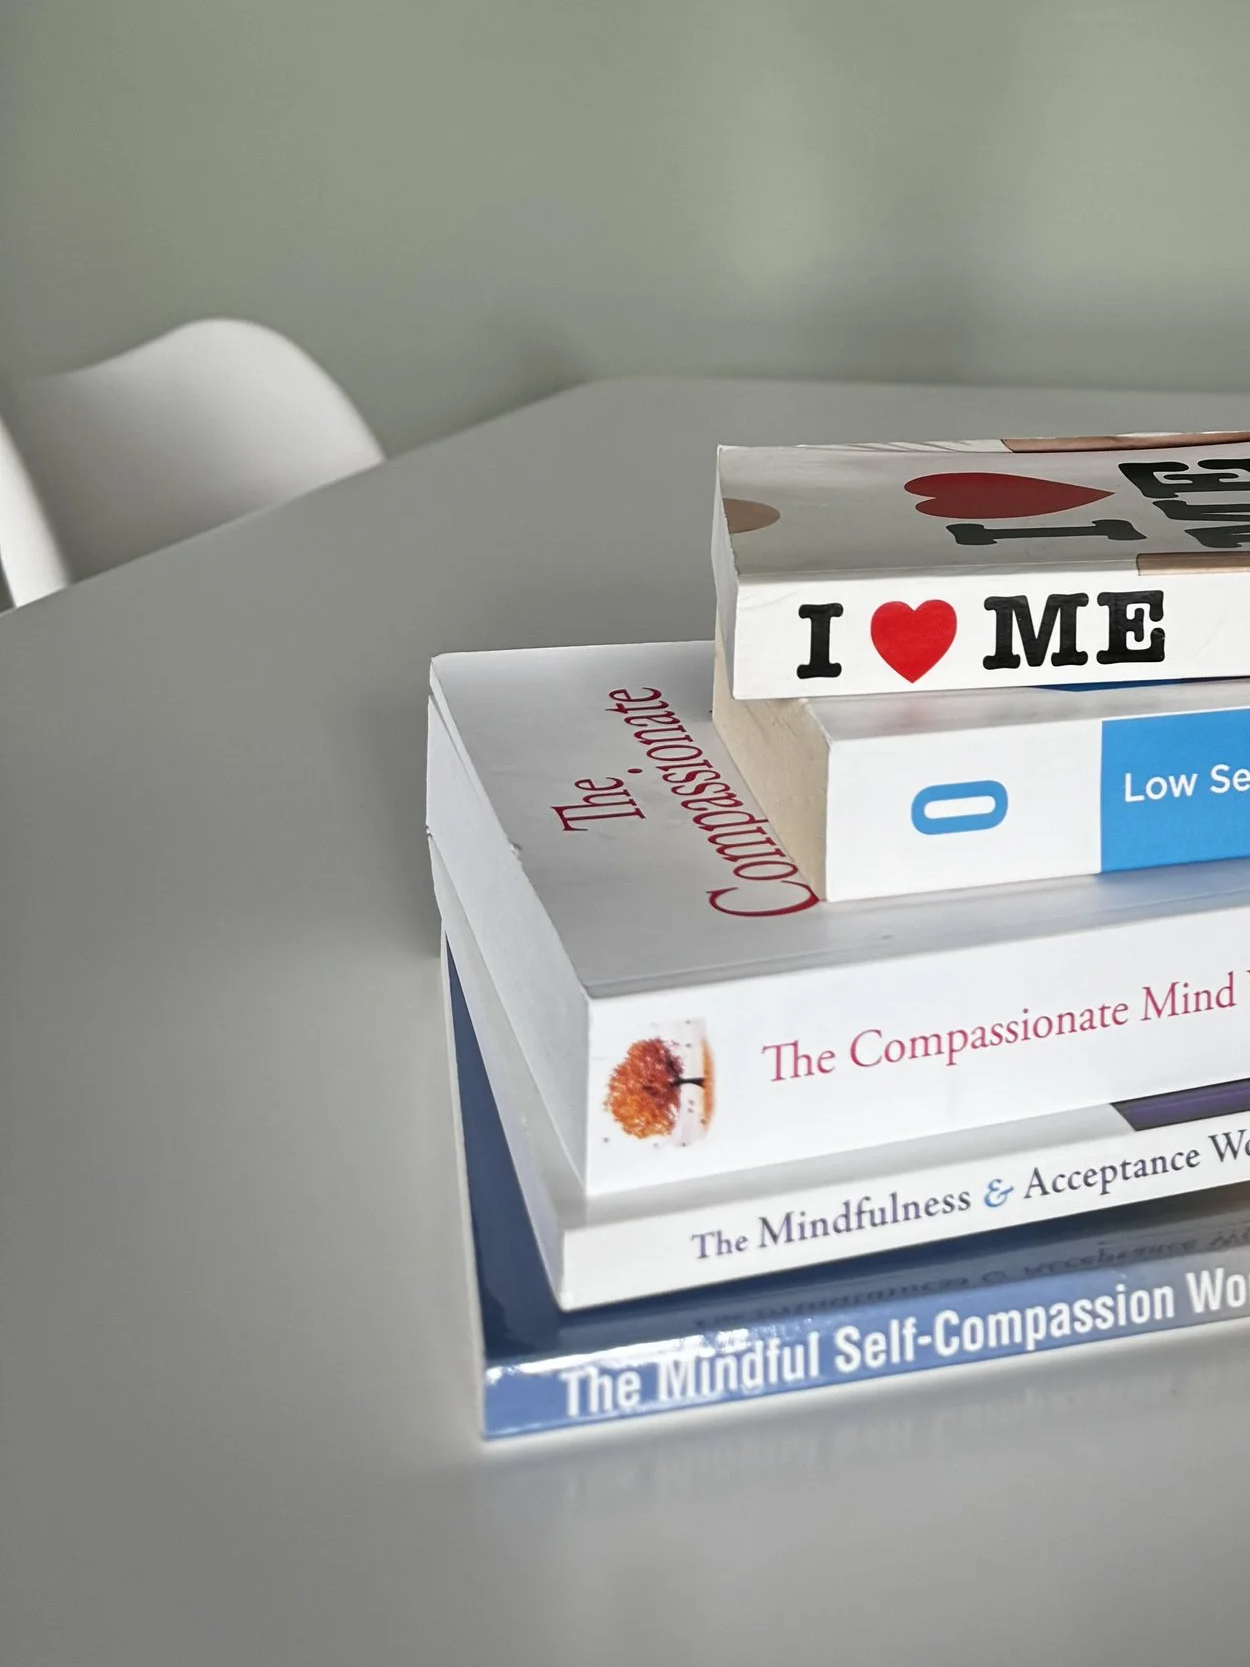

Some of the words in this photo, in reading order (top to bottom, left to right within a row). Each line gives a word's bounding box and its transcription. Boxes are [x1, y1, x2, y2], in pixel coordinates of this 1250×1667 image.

[946, 518, 1148, 546] I
[796, 602, 842, 679] I
[982, 589, 1165, 671] ME
[551, 776, 646, 832] The
[605, 686, 821, 918] Compassionate
[1124, 769, 1198, 803] Low
[762, 1041, 837, 1083] The
[848, 997, 1130, 1068] Compassionate
[1140, 972, 1237, 1025] Mind
[691, 1228, 751, 1262] The
[757, 1183, 972, 1250] Mindfulness
[983, 1178, 1015, 1208] &
[1022, 1145, 1202, 1202] Acceptance
[560, 1366, 641, 1418] The
[655, 1332, 819, 1403] Mindful
[834, 1283, 1176, 1375] Self-Compassion
